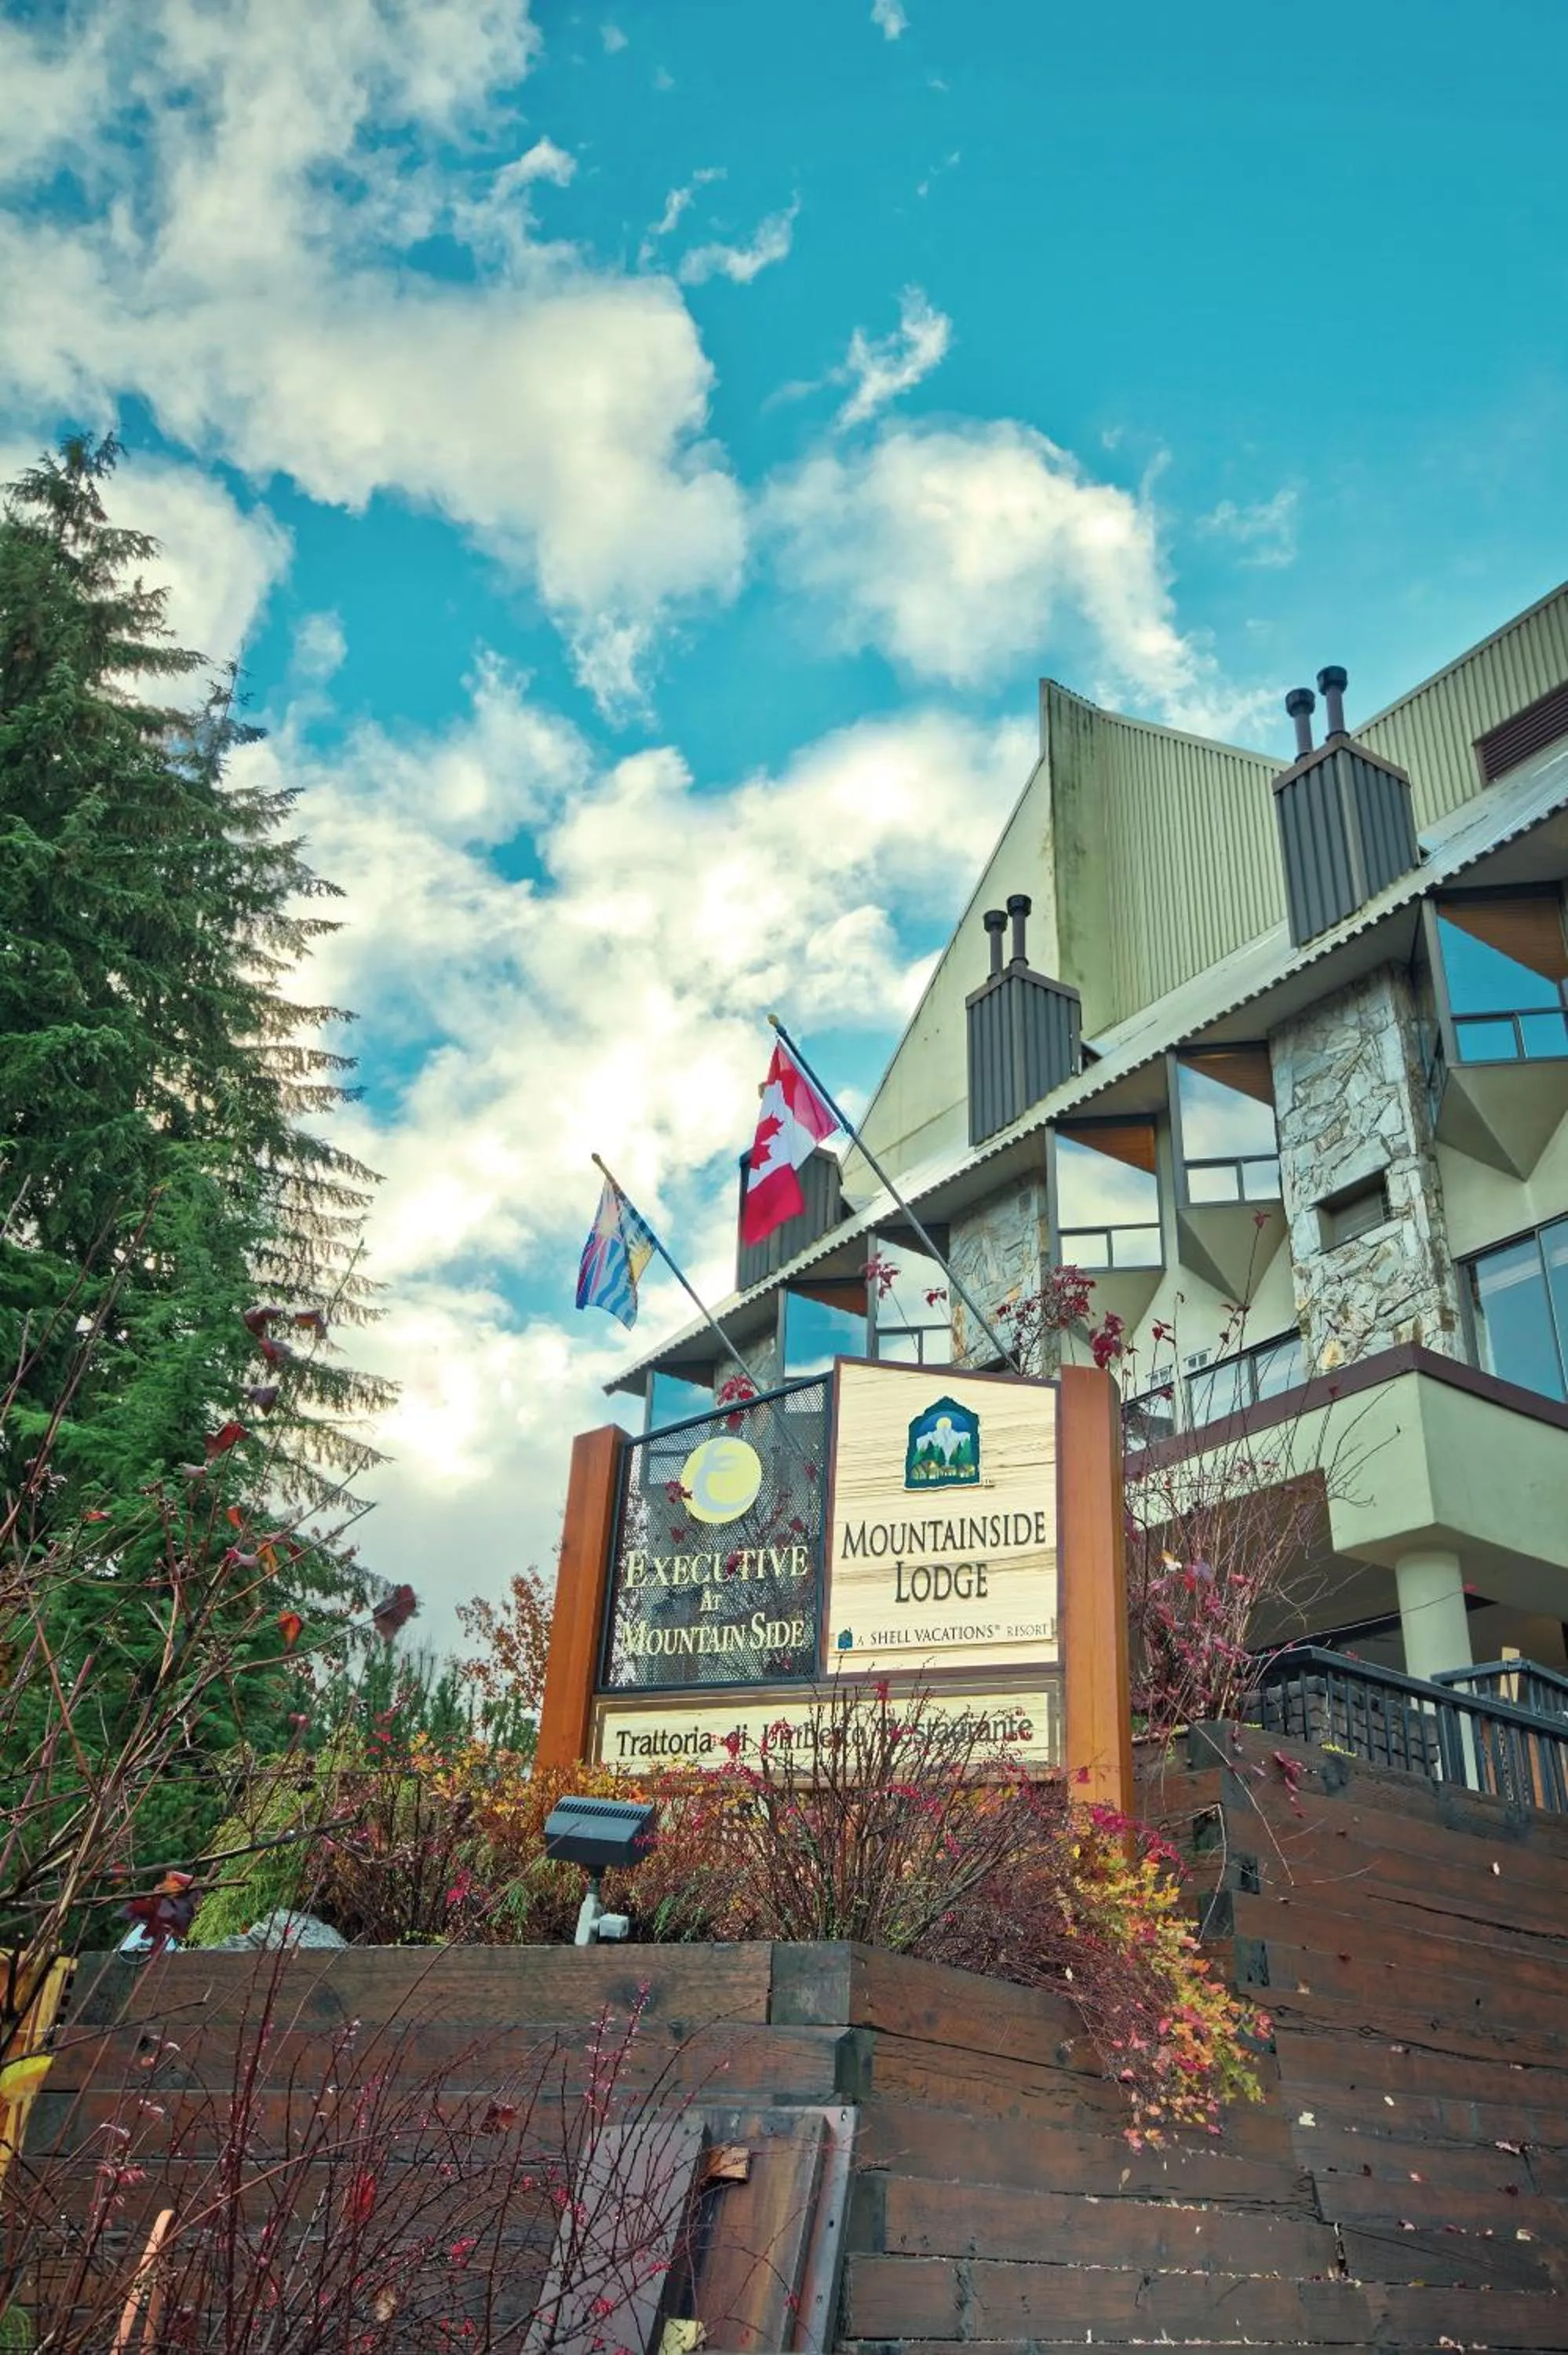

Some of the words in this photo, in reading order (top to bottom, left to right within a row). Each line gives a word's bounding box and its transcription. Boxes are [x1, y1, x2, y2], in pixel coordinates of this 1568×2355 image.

[841, 1511, 1046, 1559] MOUNTAINSIDE
[624, 1546, 809, 1589] EXECUTIVE
[895, 1561, 988, 1603] LODGE
[856, 1635, 865, 1646] A
[870, 1629, 911, 1645] SHELL
[1006, 1623, 1048, 1638] RESORT
[616, 1725, 713, 1757] Trattoria
[763, 1721, 866, 1751] Umbeo
